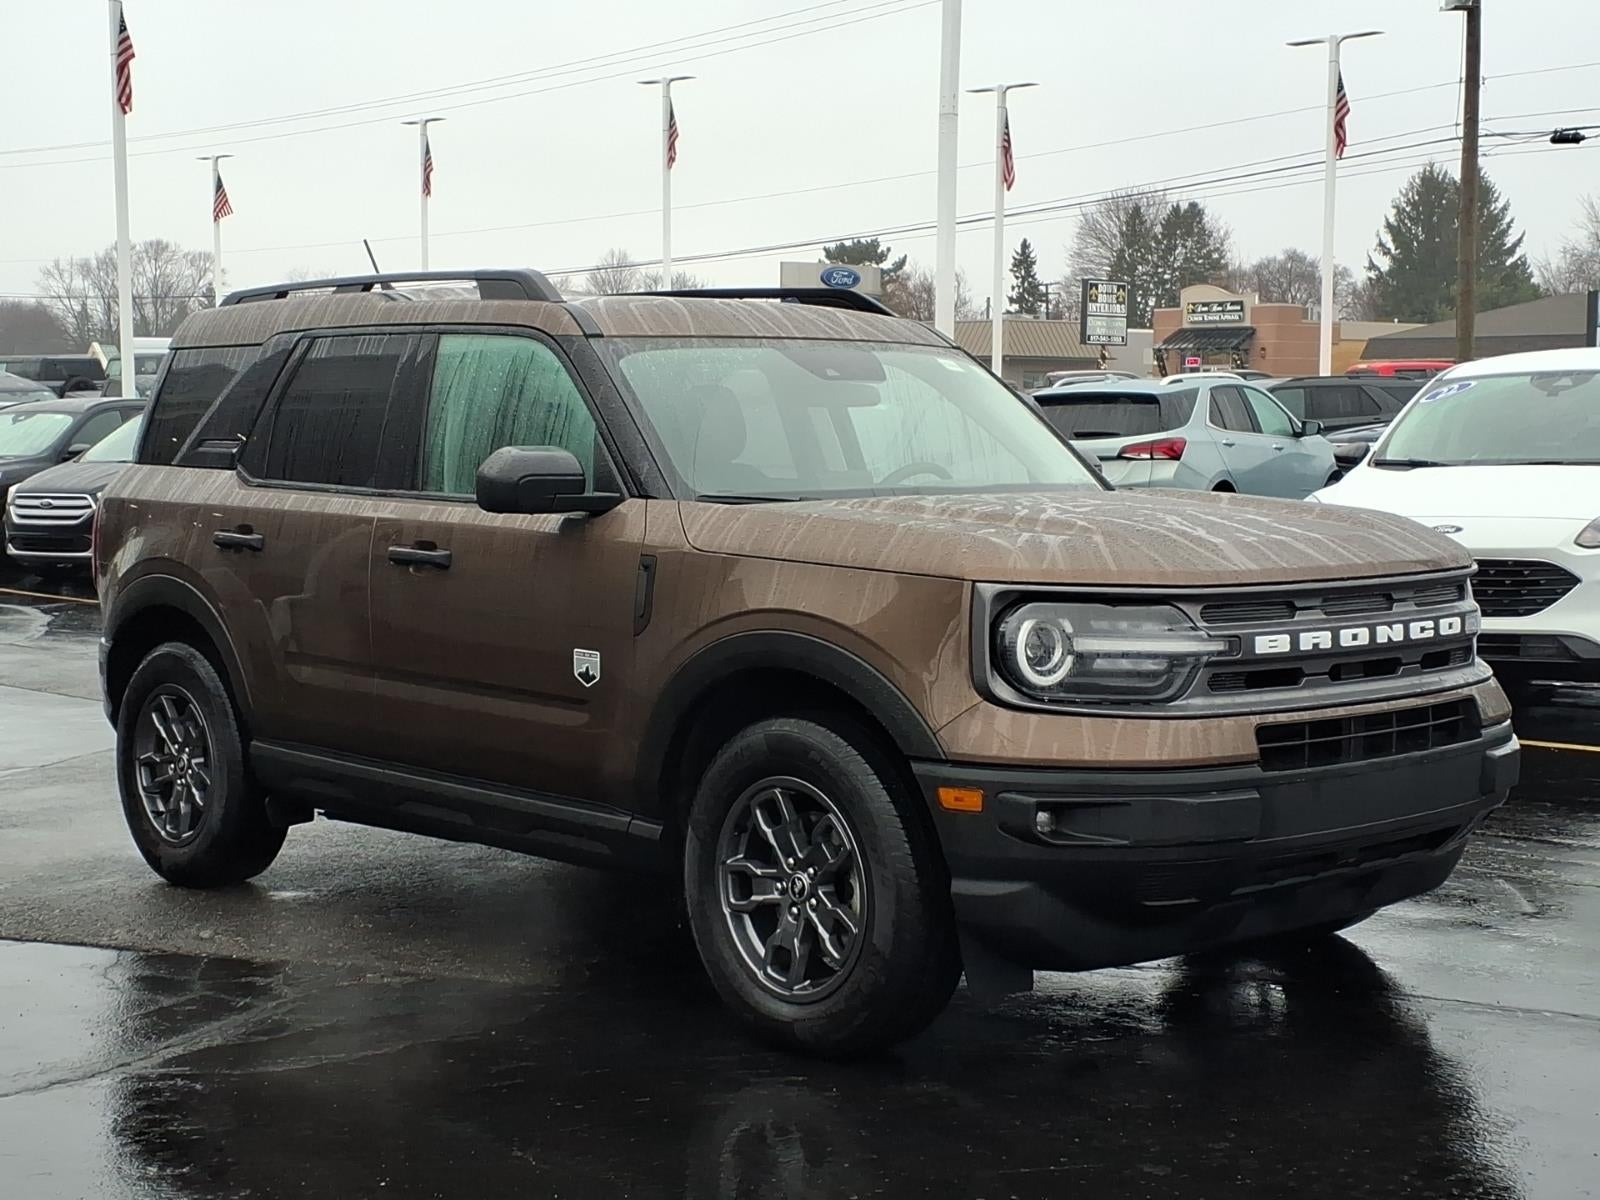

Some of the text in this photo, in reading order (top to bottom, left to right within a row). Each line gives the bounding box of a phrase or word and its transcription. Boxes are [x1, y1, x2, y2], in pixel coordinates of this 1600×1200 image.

[831, 271, 854, 285] Ford
[1098, 284, 1118, 294] DOWN
[1098, 294, 1117, 303] HOME
[1089, 303, 1126, 313] INTERIORS
[1255, 617, 1461, 654] BRONCO
